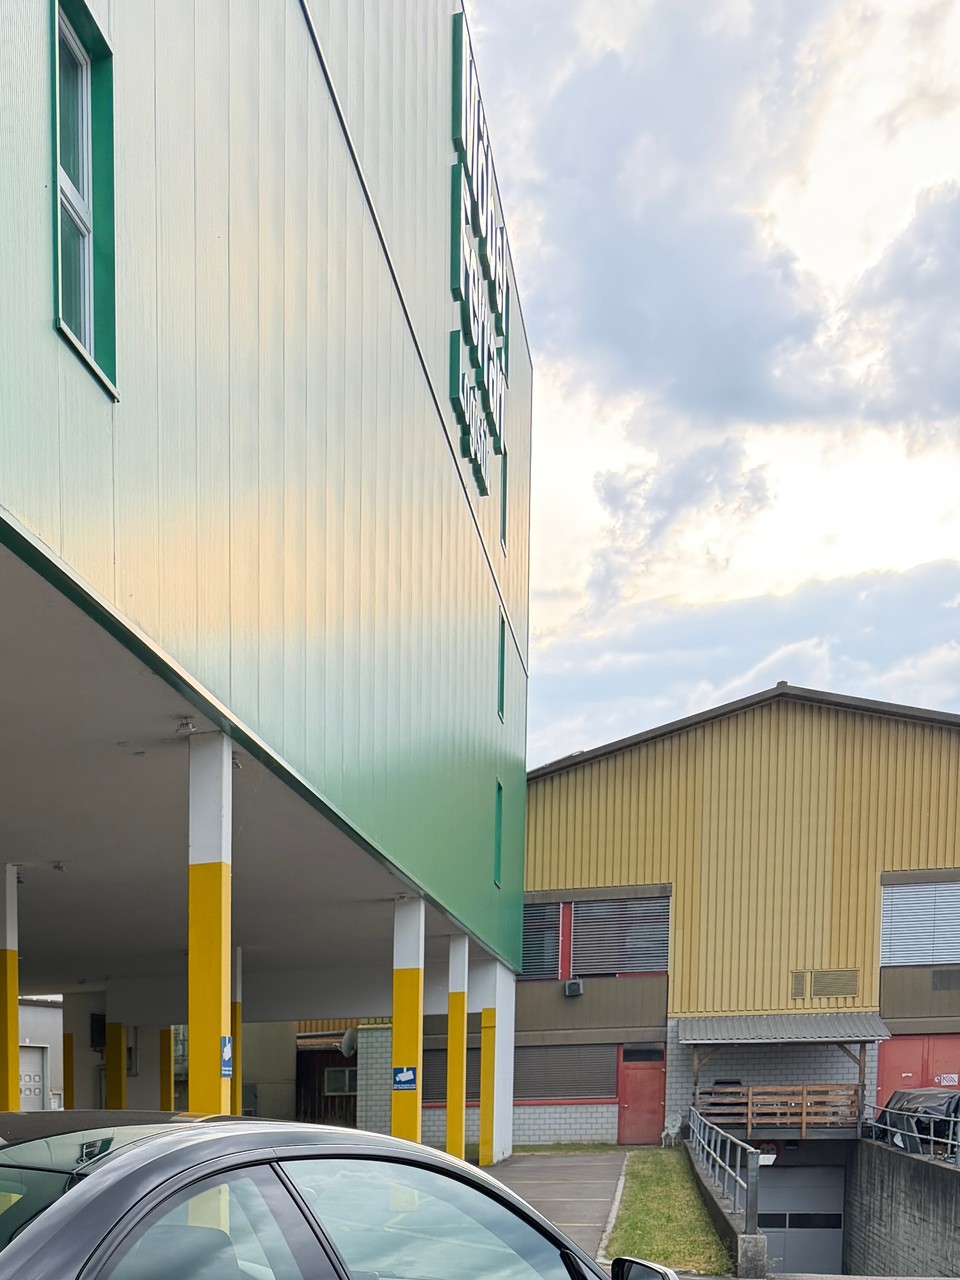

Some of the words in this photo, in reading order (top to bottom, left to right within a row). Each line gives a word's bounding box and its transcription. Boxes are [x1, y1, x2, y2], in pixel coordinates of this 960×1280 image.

[459, 163, 505, 455] Ferrari
[460, 10, 507, 336] Möbel
[458, 330, 491, 495] Logistik
